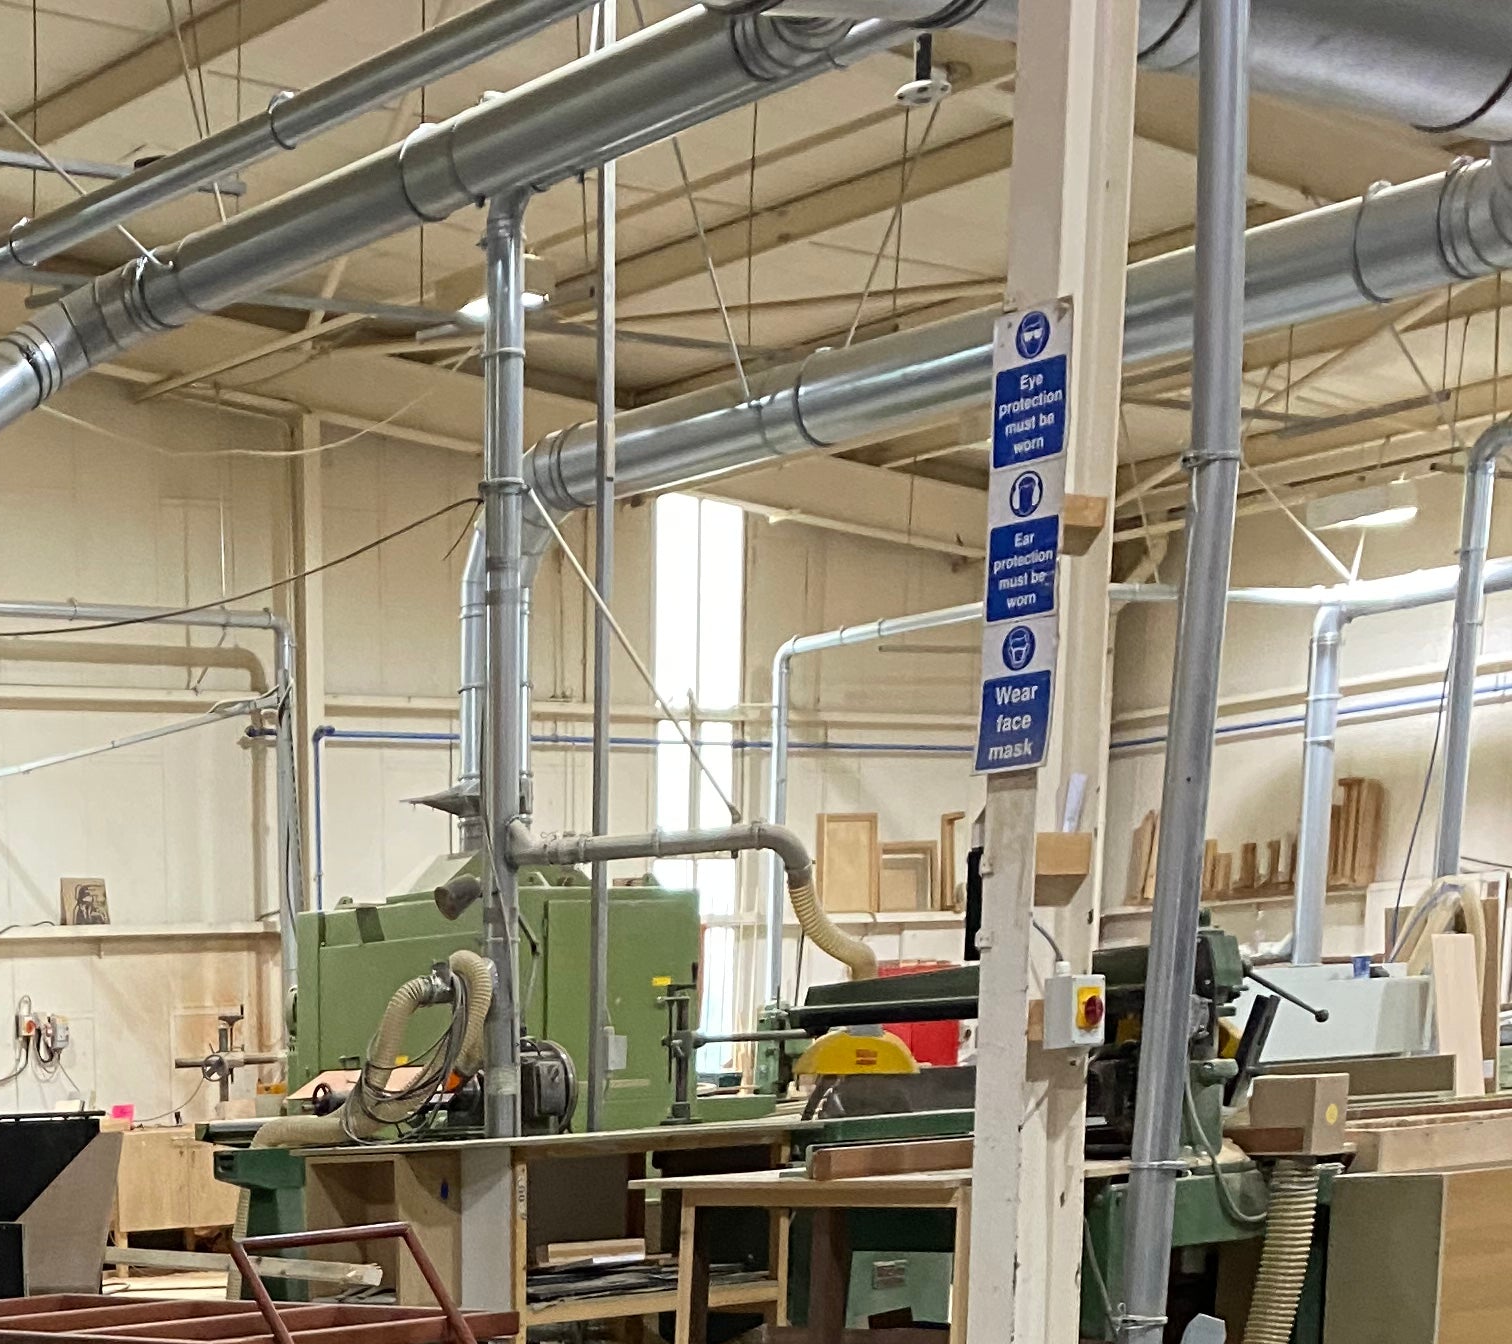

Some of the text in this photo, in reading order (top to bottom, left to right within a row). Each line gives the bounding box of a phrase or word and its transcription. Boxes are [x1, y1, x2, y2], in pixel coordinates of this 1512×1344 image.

[1020, 374, 1043, 390] Eye
[999, 390, 1062, 420] protection
[1005, 413, 1055, 437] must be
[1014, 437, 1044, 454] worn
[1014, 533, 1034, 547] Ear
[993, 549, 1053, 574] protection
[999, 570, 1046, 591] must be
[1006, 593, 1036, 609] worn
[996, 686, 1038, 705] Wear
[997, 714, 1032, 733] face
[988, 738, 1033, 761] mask
